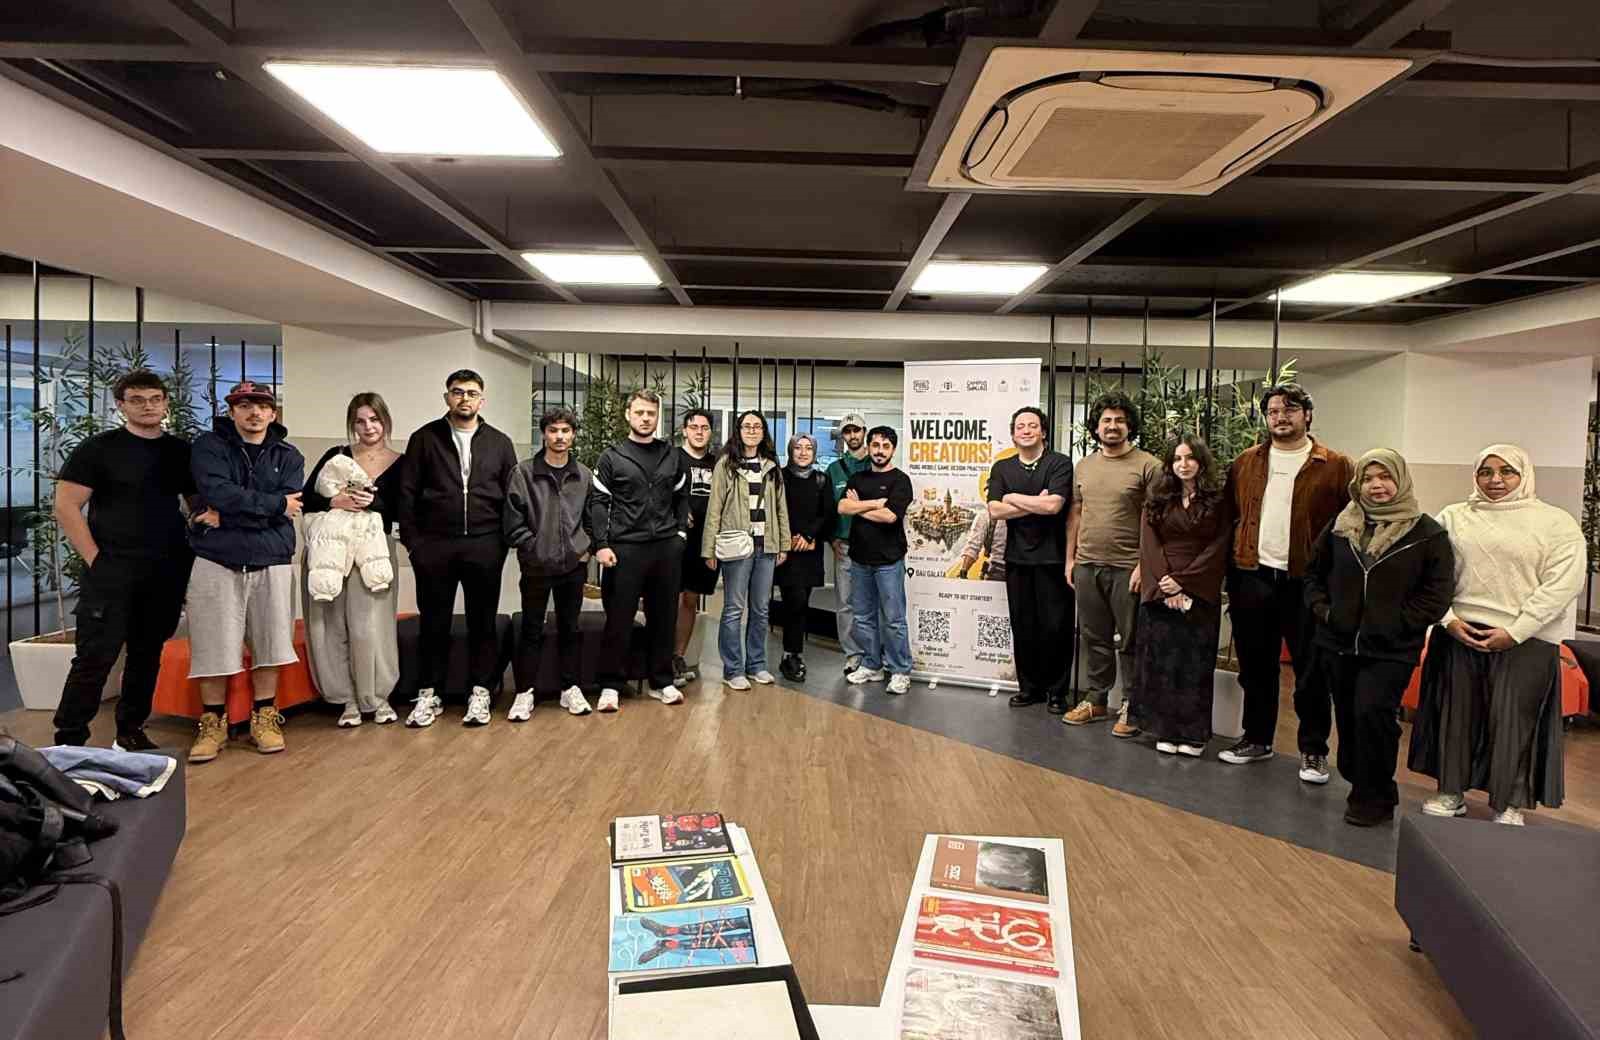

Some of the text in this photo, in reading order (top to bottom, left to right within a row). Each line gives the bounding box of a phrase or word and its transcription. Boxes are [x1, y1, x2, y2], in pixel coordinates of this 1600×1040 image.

[910, 420, 992, 442] WELCOME,
[910, 442, 992, 464] CREATORS!
[927, 569, 946, 578] GALATA
